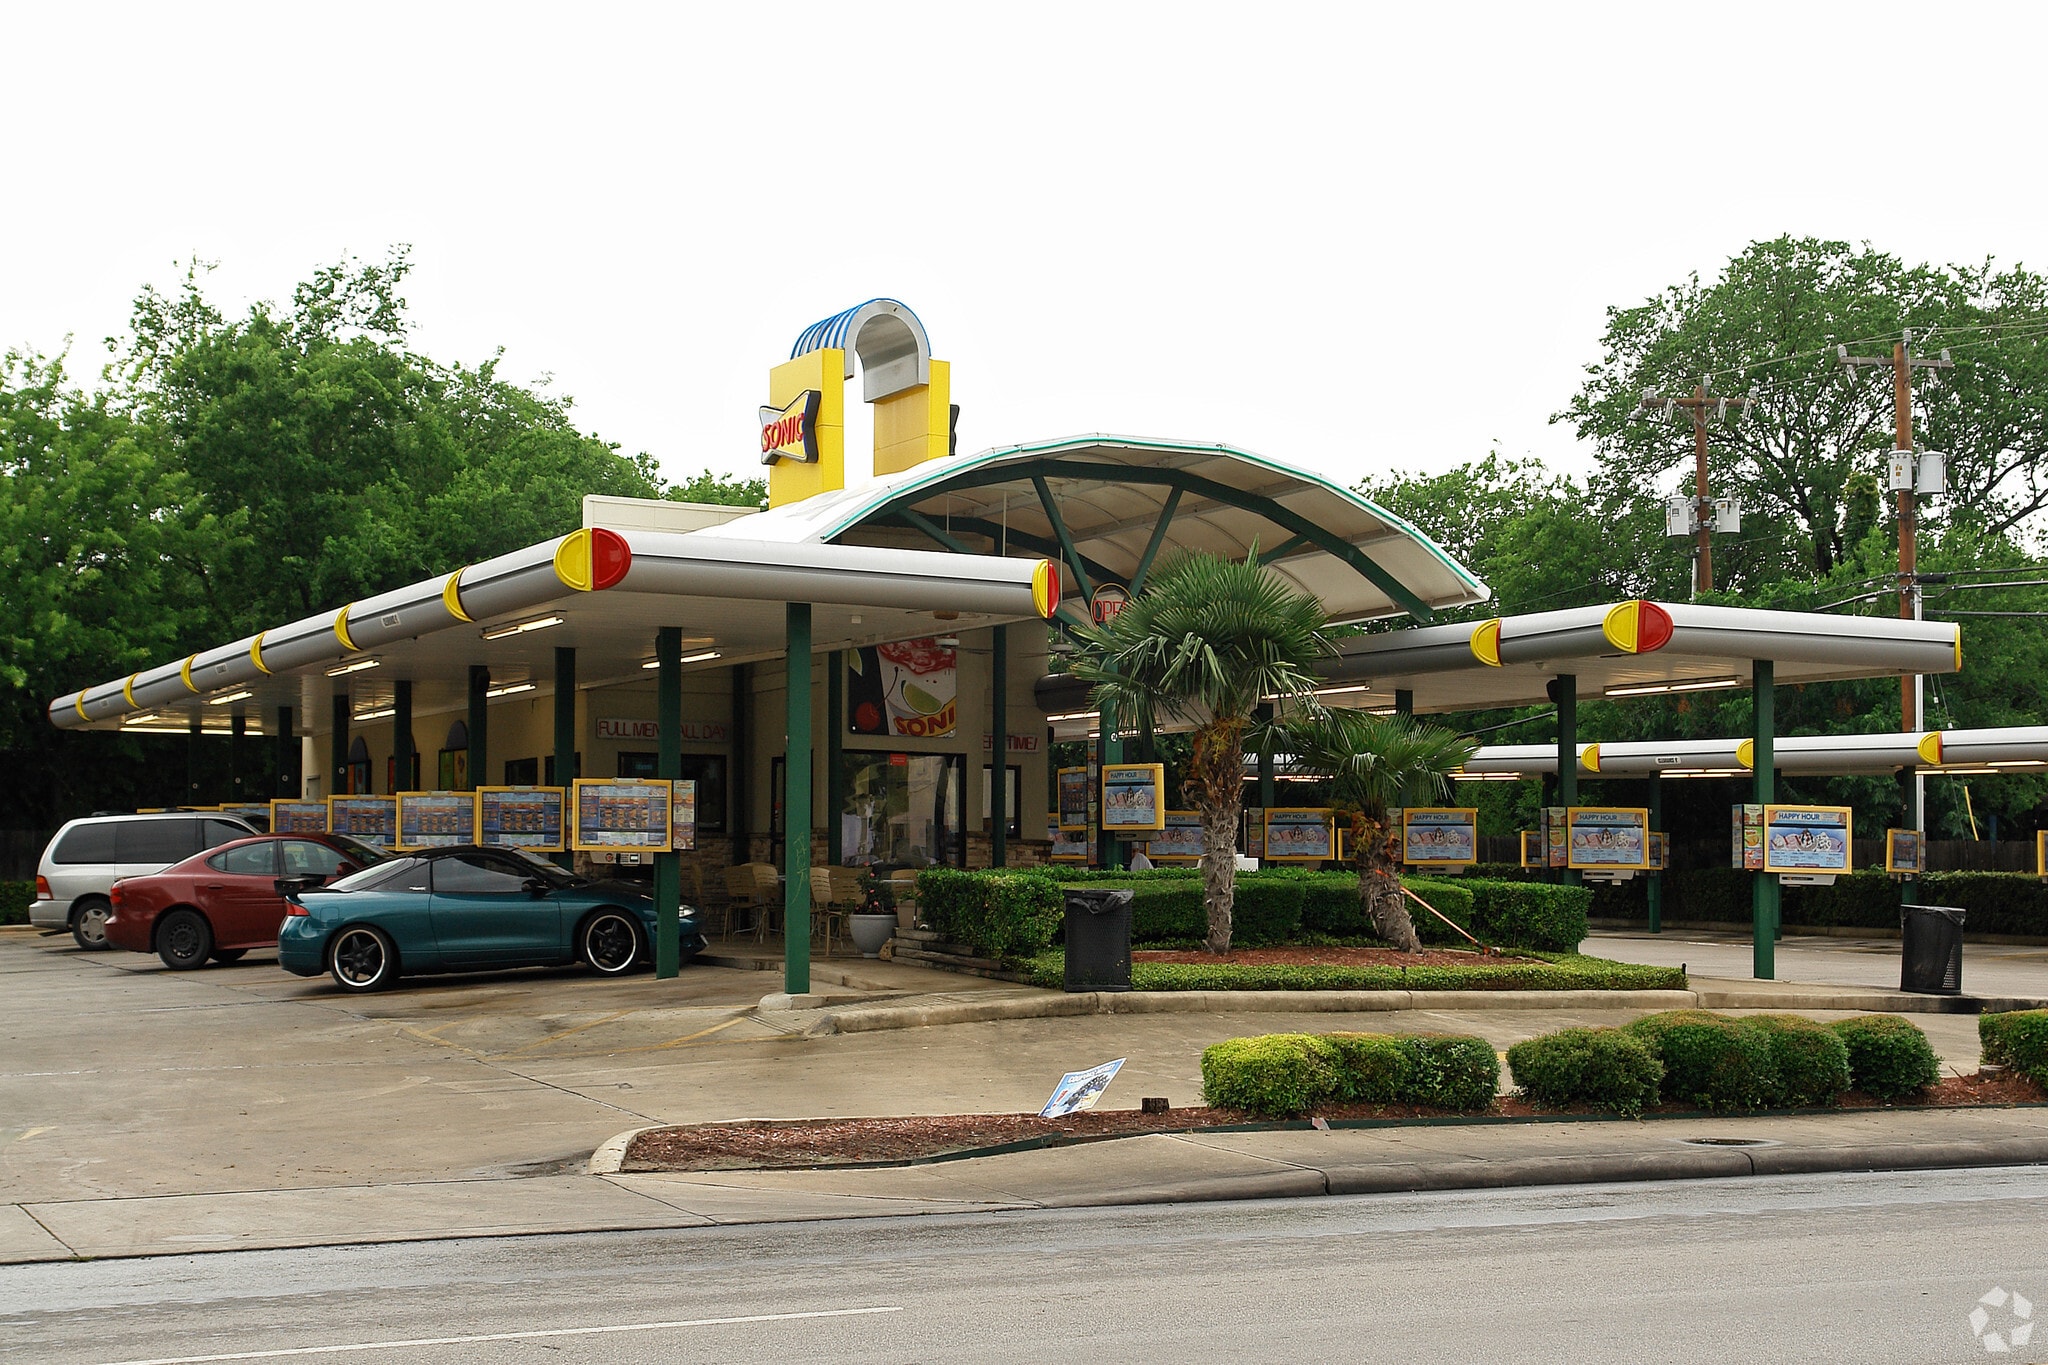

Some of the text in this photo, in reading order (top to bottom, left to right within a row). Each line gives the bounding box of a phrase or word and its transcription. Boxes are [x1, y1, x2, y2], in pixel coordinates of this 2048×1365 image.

[763, 412, 805, 452] SONIC
[1093, 599, 1127, 623] OPE
[599, 720, 630, 737] FULL
[632, 722, 660, 738] MEN
[1778, 812, 1800, 820] HAPPY
